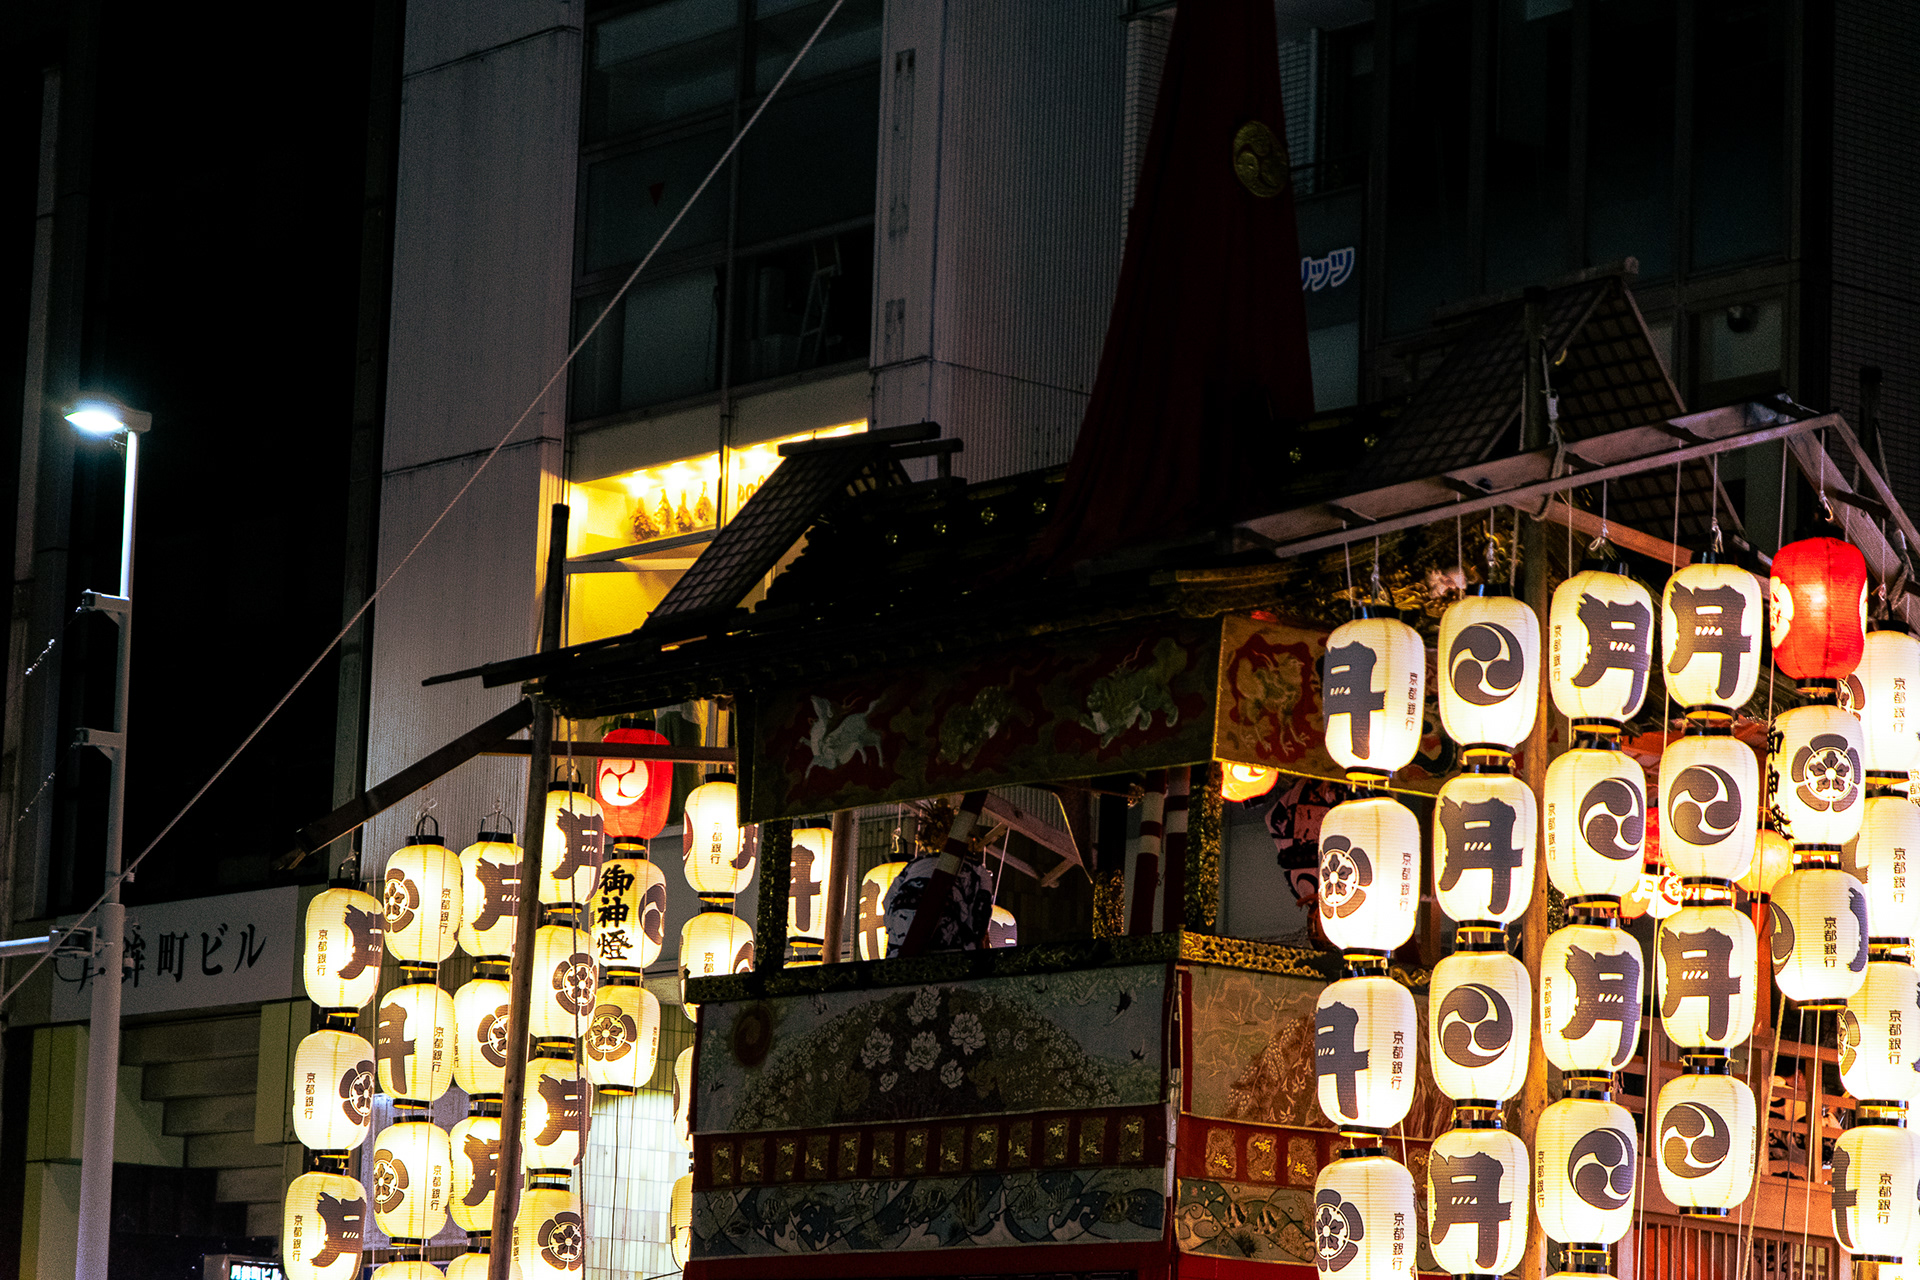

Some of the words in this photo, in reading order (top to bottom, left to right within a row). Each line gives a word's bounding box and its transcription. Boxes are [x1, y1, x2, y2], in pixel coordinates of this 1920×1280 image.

[1667, 581, 1752, 700] 月
[1893, 677, 1907, 733] 京都銀行
[710, 822, 723, 865] 京都銀行
[1438, 795, 1524, 916] 月
[1893, 847, 1907, 903] 京都銀行
[440, 888, 452, 934] 京都銀行
[596, 864, 635, 961] 御神燈
[316, 929, 328, 976] 京都銀行
[703, 952, 715, 974] 京都
[1824, 916, 1838, 968] 京都銀行
[1659, 927, 1742, 1042] 月
[433, 1026, 445, 1073] 京都銀行
[1391, 1031, 1405, 1090] 京都銀行
[1888, 1009, 1903, 1065] 京都銀行
[304, 1072, 316, 1120] 京都銀行
[430, 1165, 443, 1211] 京都銀行
[1430, 1149, 1513, 1269] 月
[1877, 1173, 1893, 1224] 京都銀行
[292, 1214, 304, 1262] 京都銀行
[1392, 1212, 1405, 1271] 京都銀行
